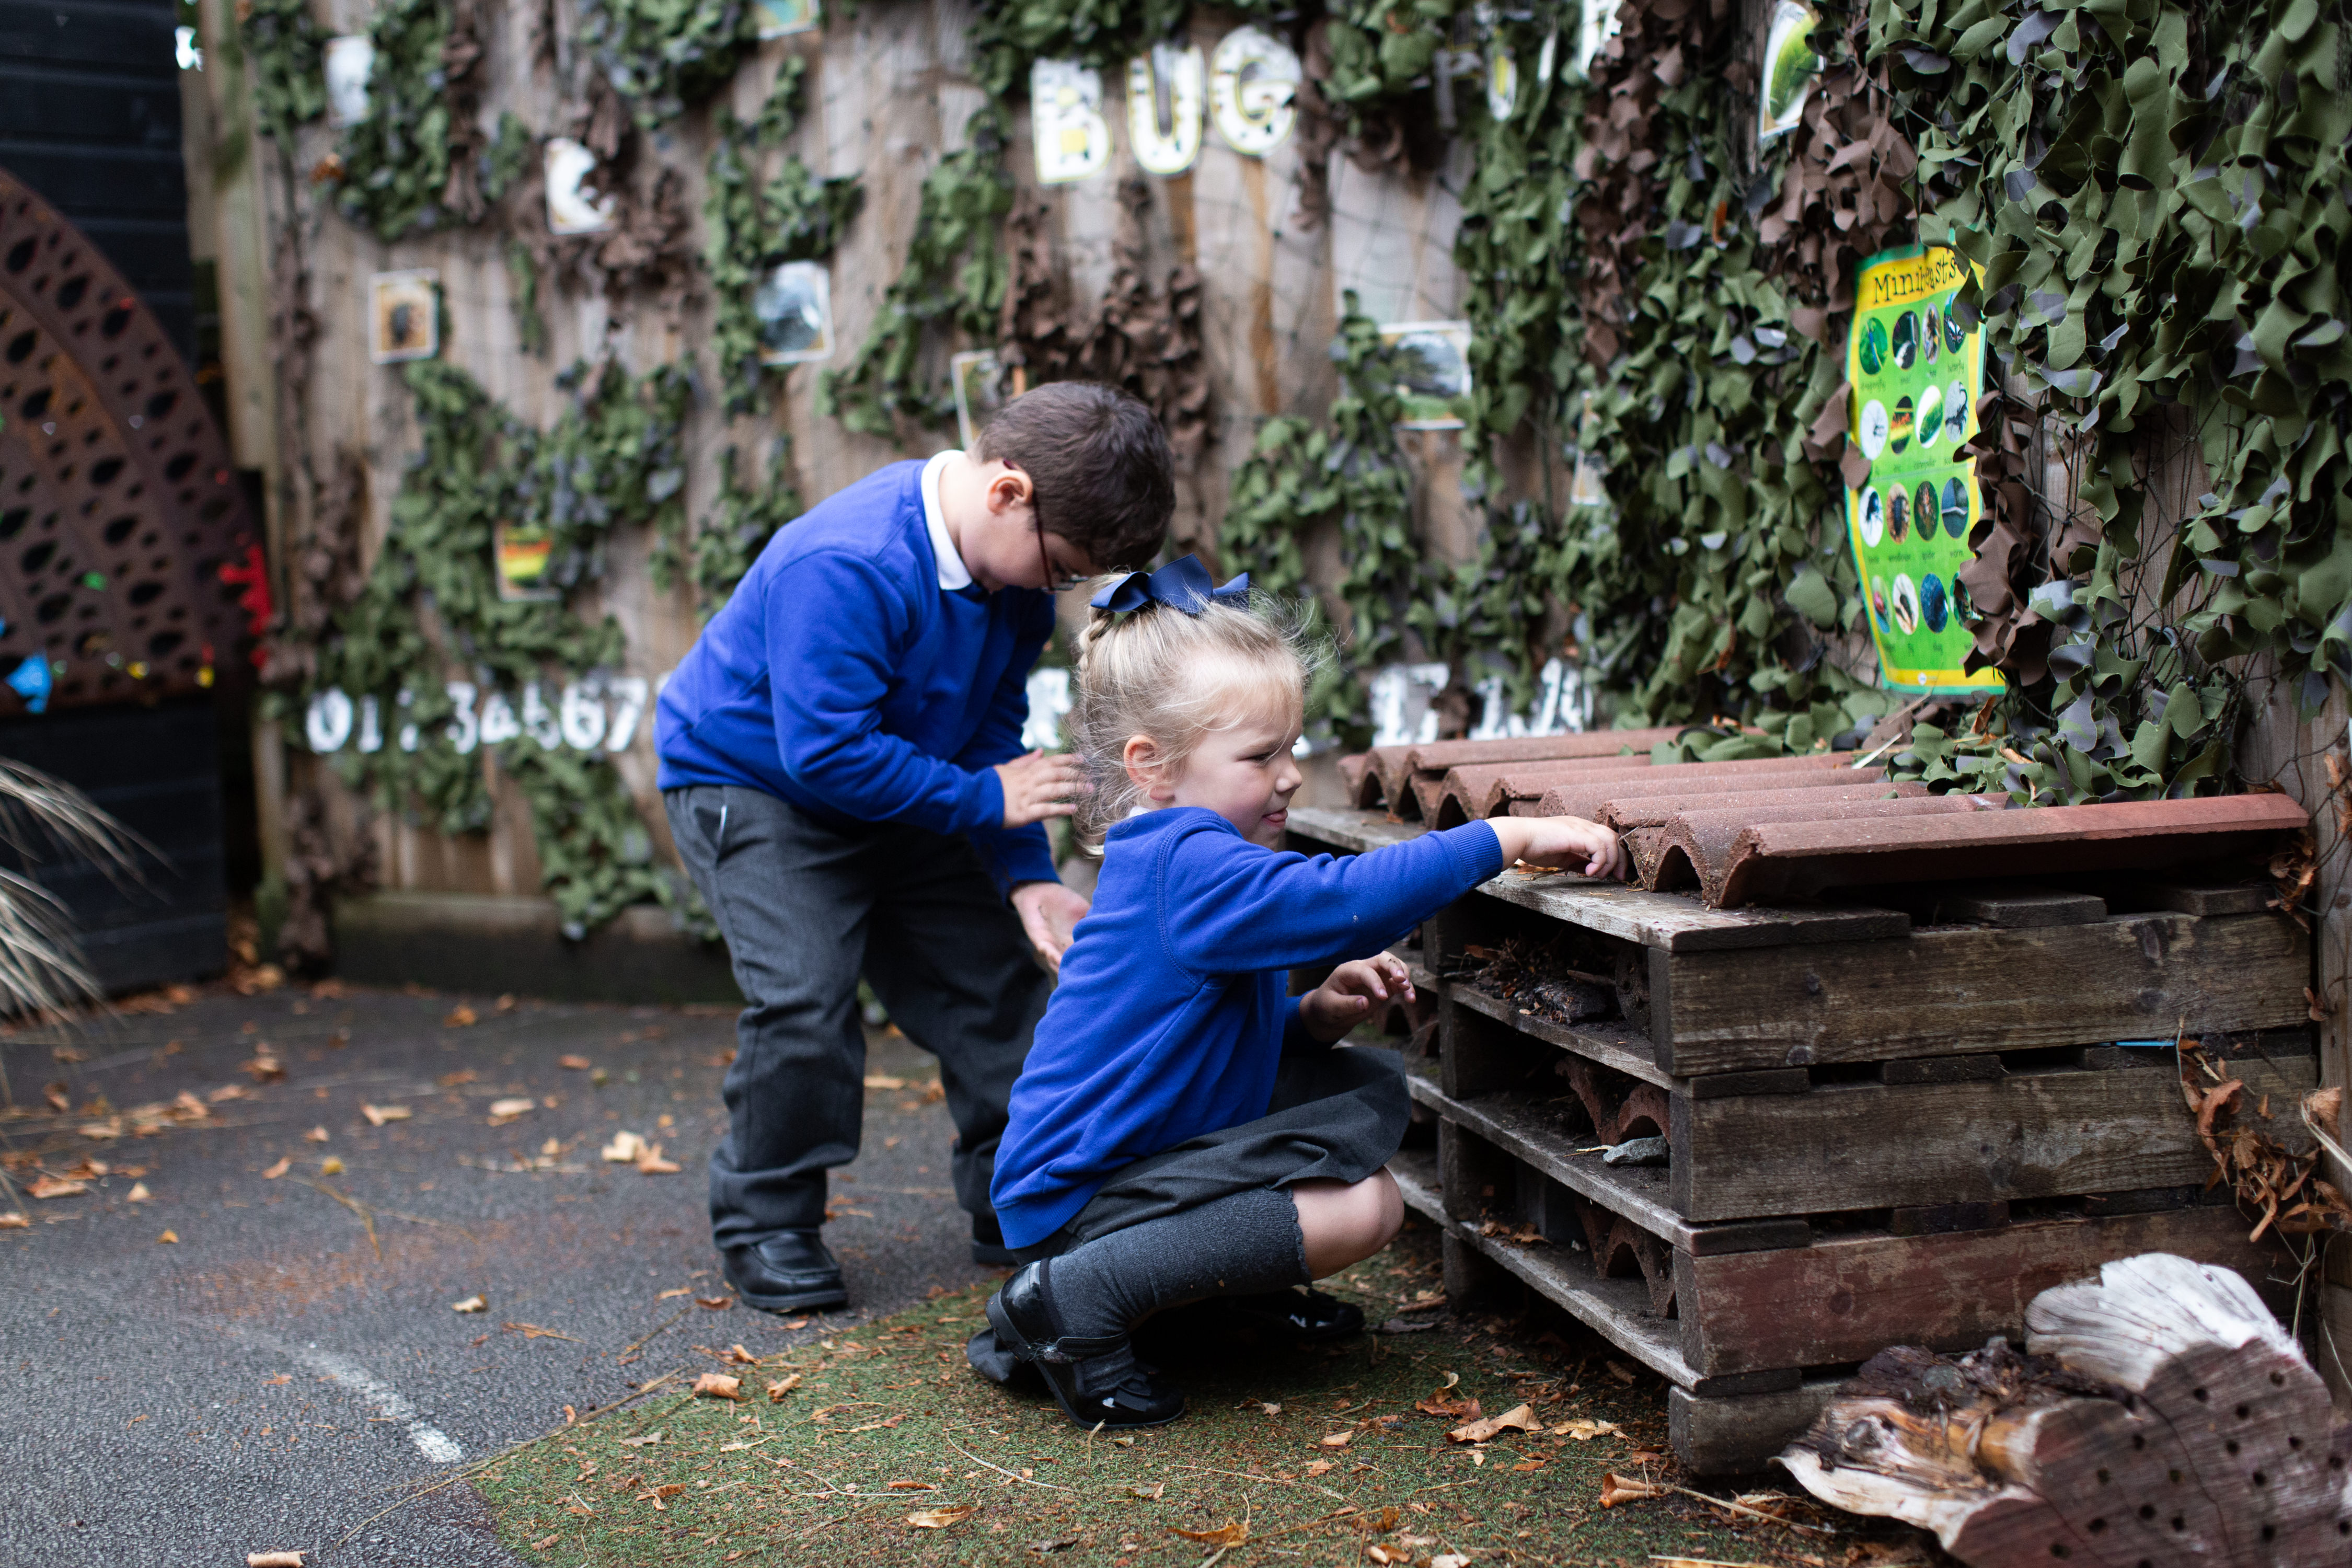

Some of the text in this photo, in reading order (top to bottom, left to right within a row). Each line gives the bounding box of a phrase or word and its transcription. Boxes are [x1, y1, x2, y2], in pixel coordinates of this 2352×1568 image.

[1030, 24, 1302, 184] BUG
[1873, 254, 1957, 304] Minibeasts
[1950, 549, 1964, 558] worm
